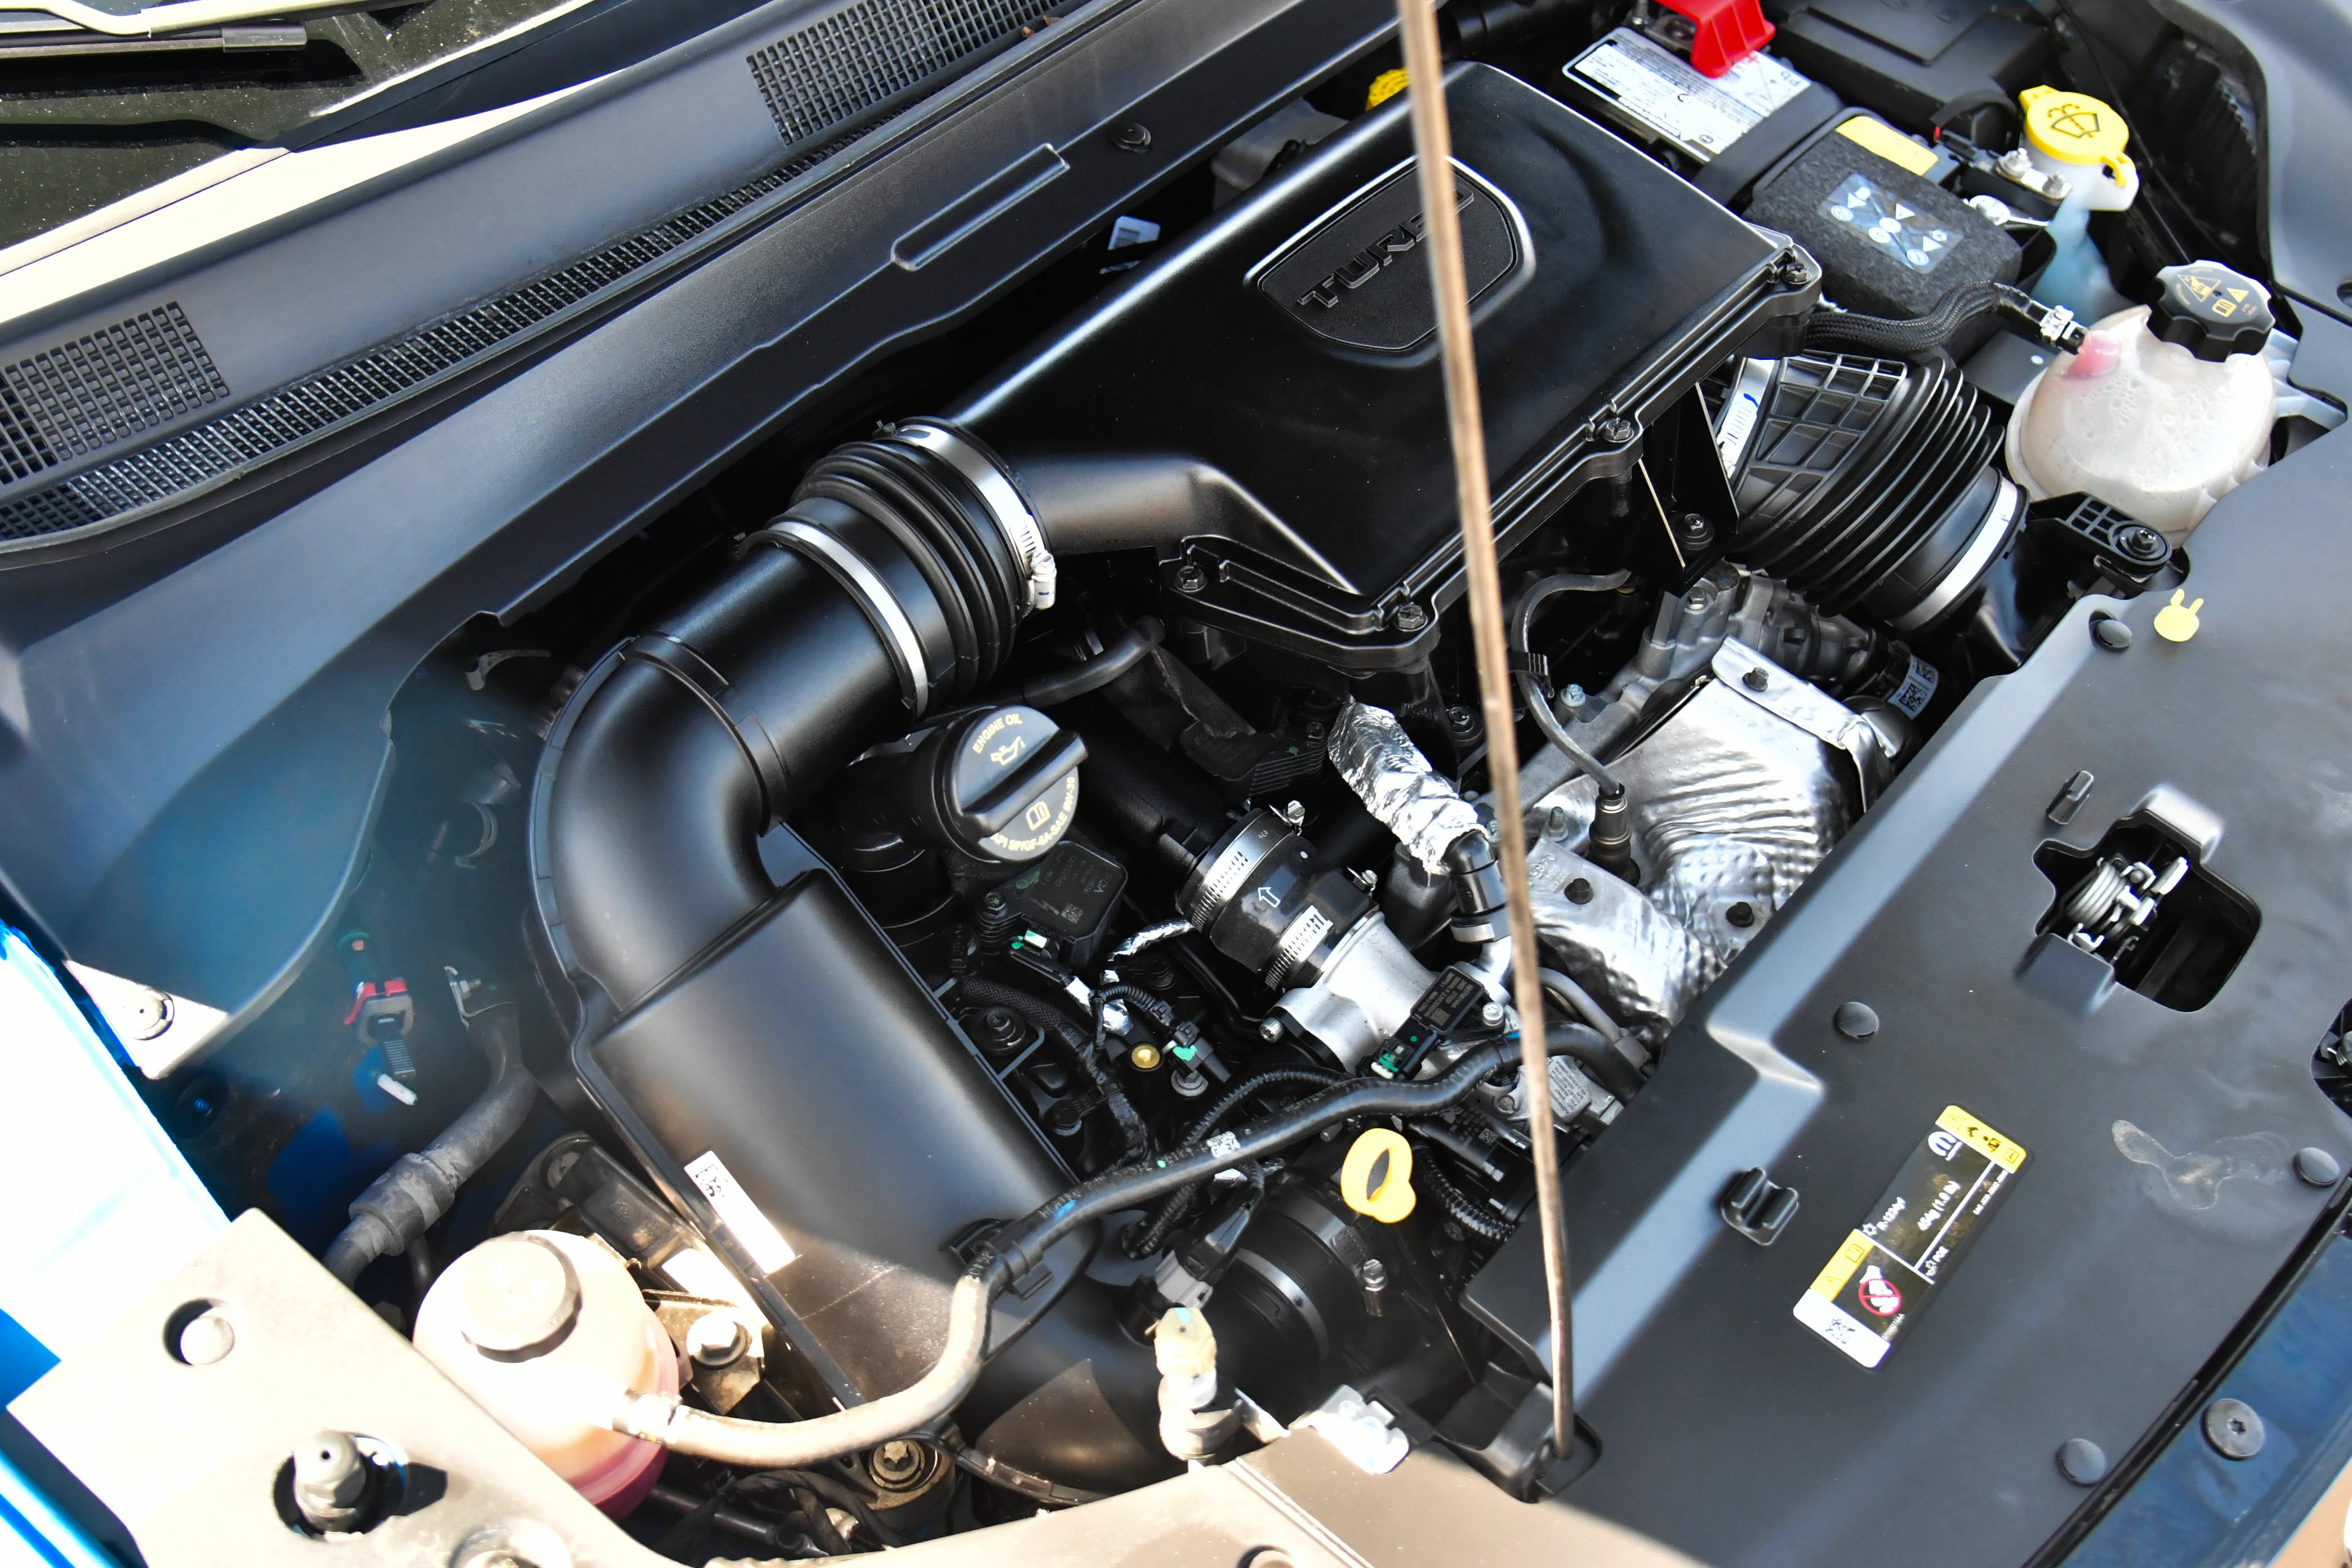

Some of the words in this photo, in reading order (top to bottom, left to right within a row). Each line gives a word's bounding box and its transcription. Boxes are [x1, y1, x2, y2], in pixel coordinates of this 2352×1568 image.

[973, 718, 1005, 754] ENGINE
[1005, 714, 1023, 725] OIL
[990, 832, 1009, 847] API
